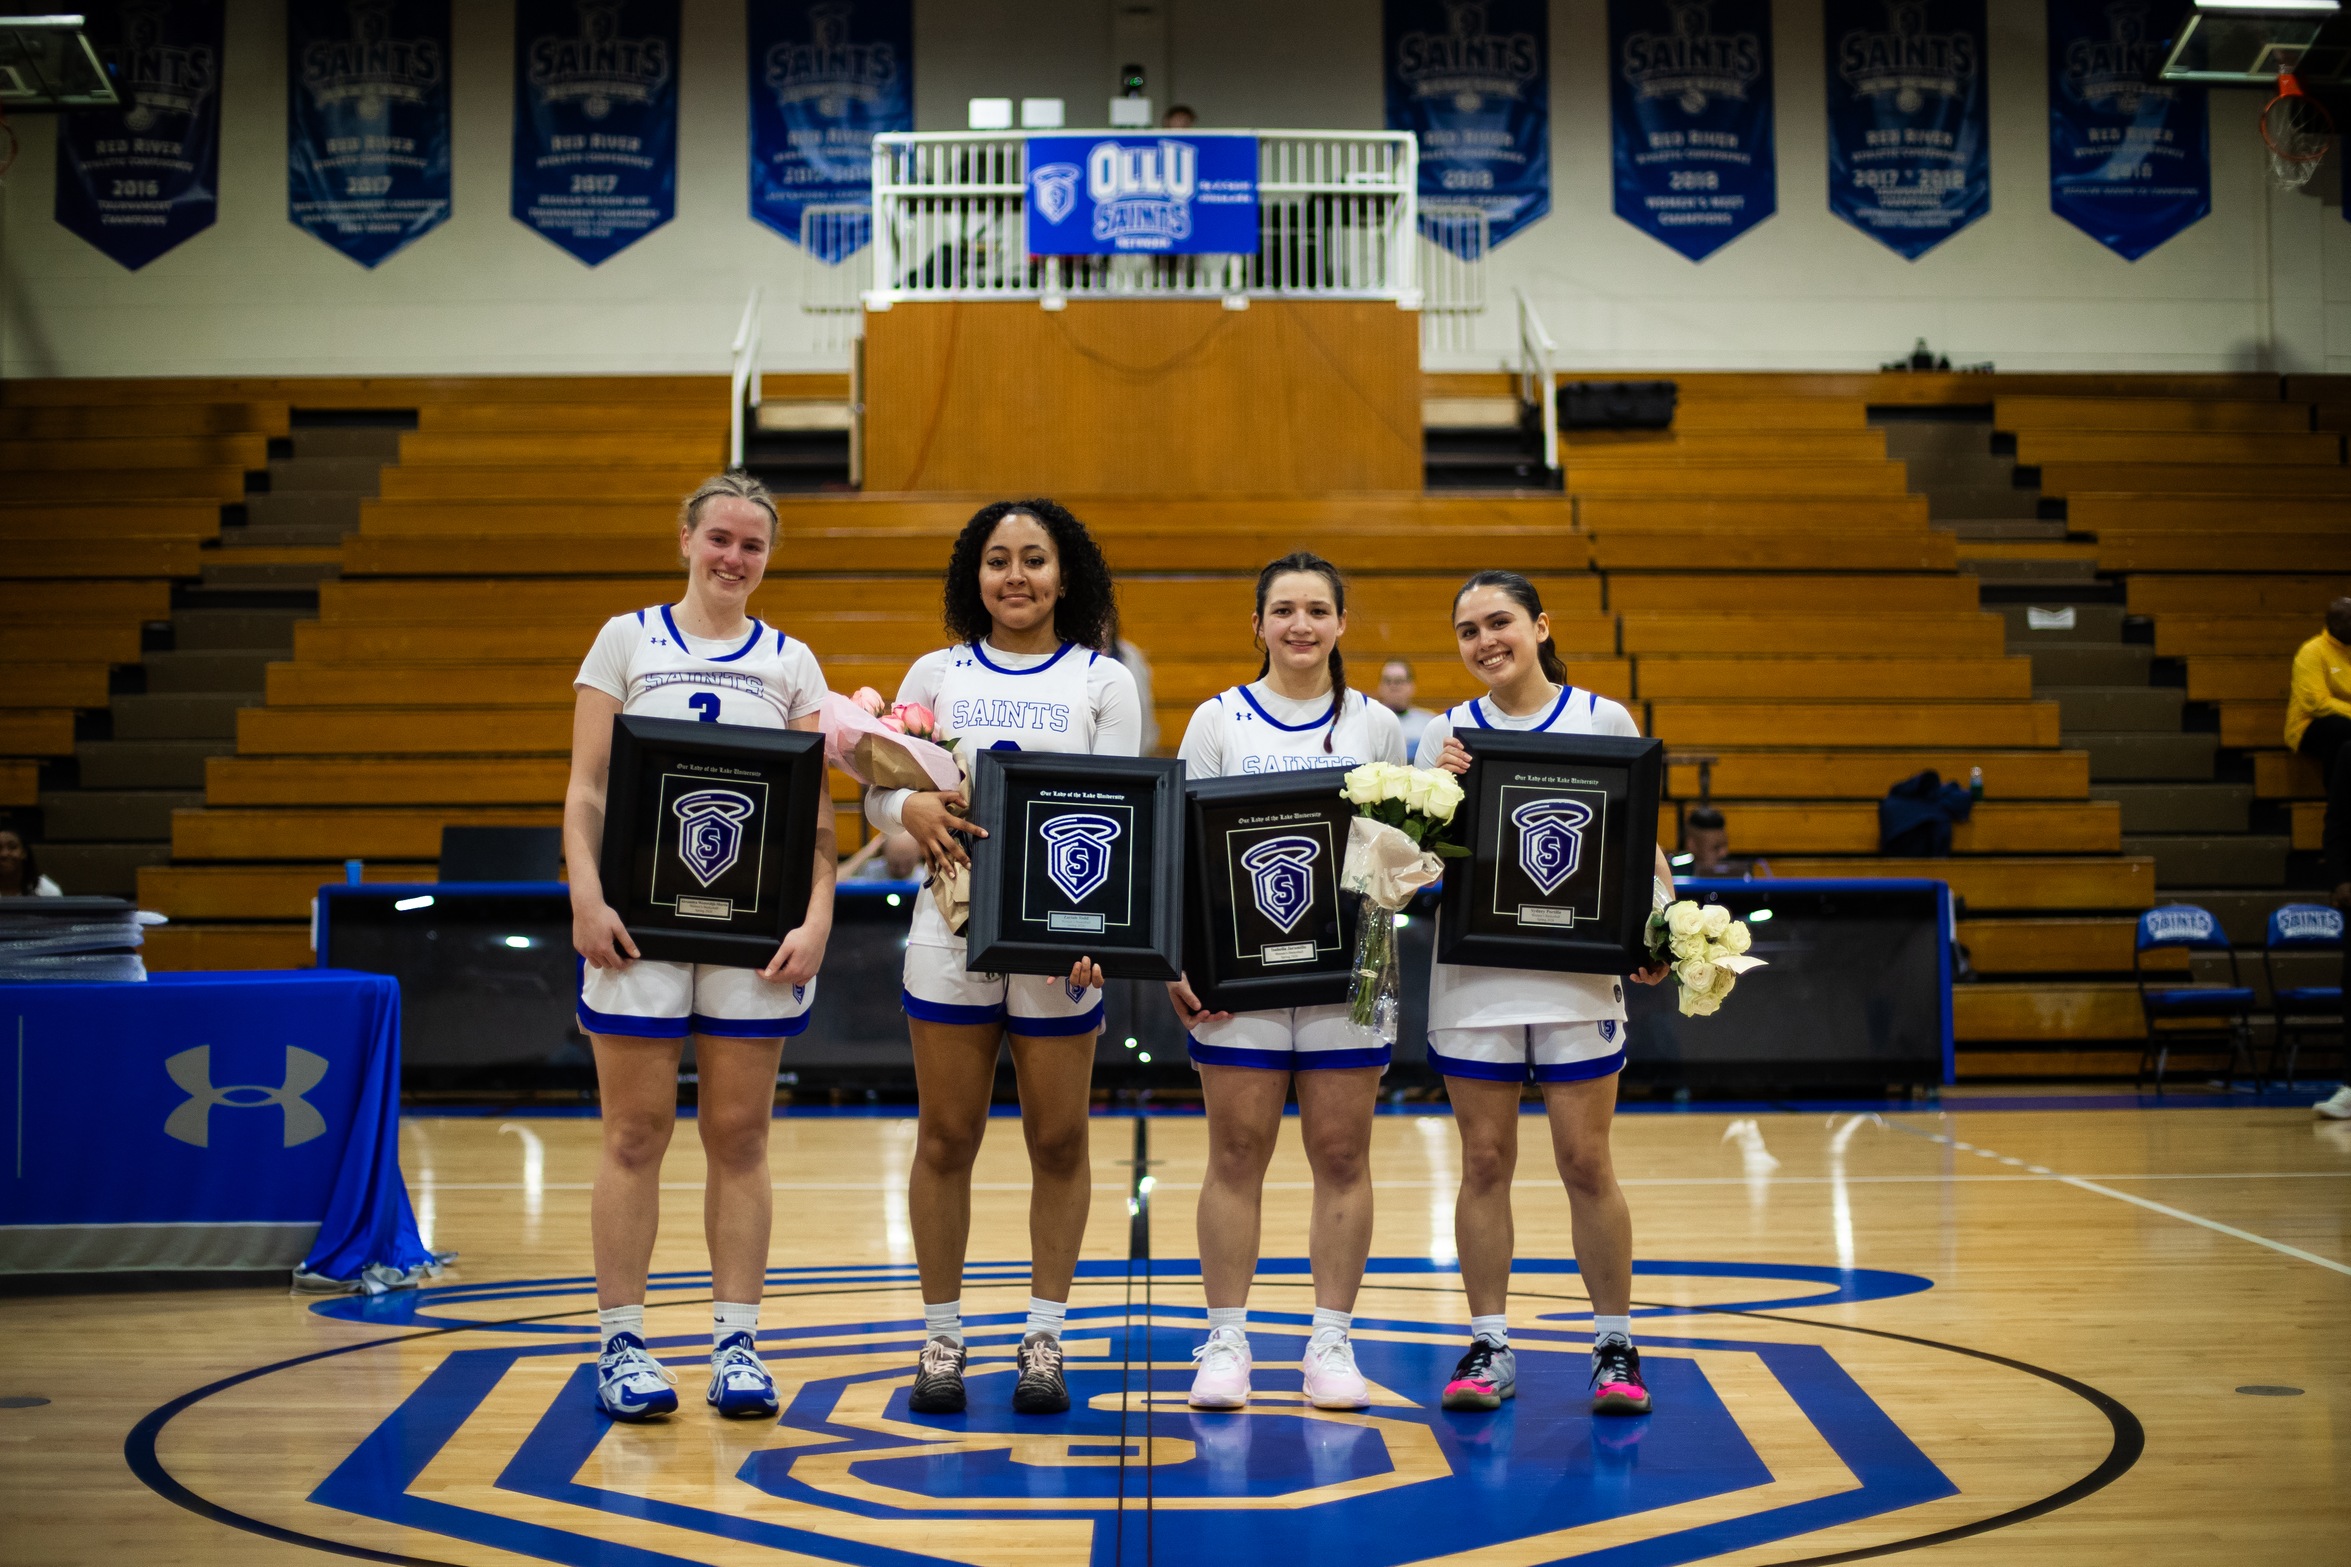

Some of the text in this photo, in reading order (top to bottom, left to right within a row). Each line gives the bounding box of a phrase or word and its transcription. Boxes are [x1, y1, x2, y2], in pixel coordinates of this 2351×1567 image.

[303, 37, 442, 84] SAINTS
[528, 36, 668, 85] SAINTS
[767, 42, 895, 87] SAINTS
[1397, 34, 1541, 81] SAINTS
[1623, 33, 1761, 81] SAINTS
[1841, 32, 1975, 80] SAINTS
[1088, 141, 1196, 201] OLLU
[1092, 200, 1191, 240] SAINTS
[645, 671, 764, 698] SAINTS
[952, 698, 1070, 732] SAINTS
[1097, 792, 1125, 801] University
[1571, 777, 1599, 786] University
[697, 827, 721, 860] S
[1536, 836, 1560, 868] S
[1065, 847, 1090, 878] S
[1271, 874, 1295, 906] S
[2147, 910, 2213, 932] SAINTS
[2277, 908, 2343, 931] SAINTS
